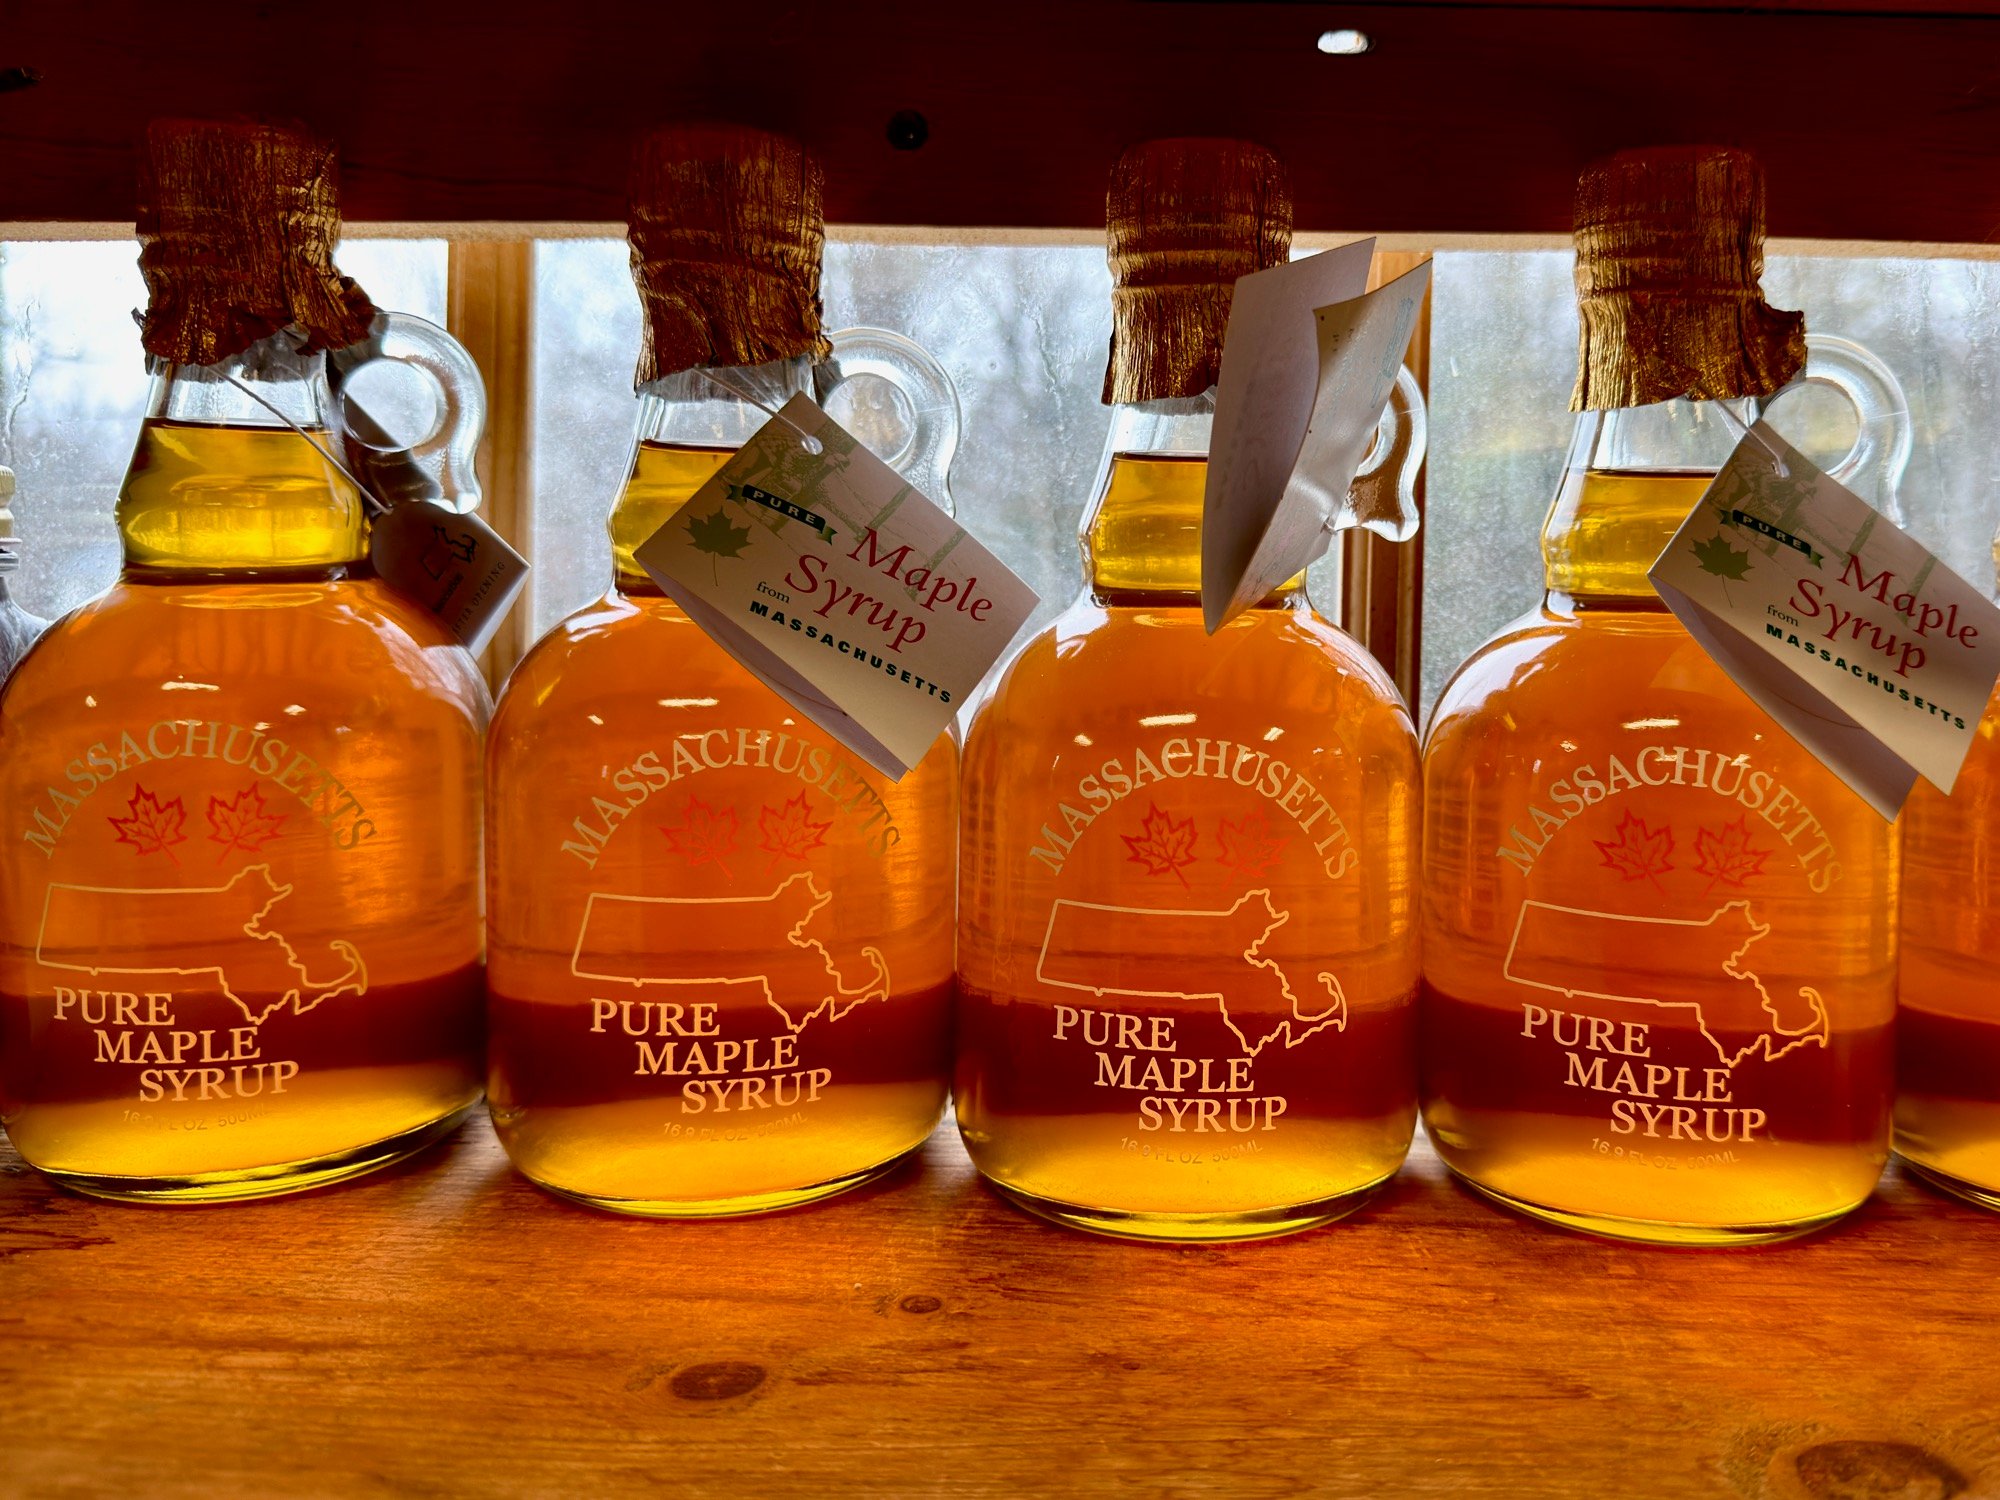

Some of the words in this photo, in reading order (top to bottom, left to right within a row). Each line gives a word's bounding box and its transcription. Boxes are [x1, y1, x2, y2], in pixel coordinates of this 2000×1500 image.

[751, 489, 817, 525] PURE
[1742, 514, 1801, 549] PURE
[473, 561, 506, 606] OPENING
[756, 581, 791, 604] from
[847, 526, 993, 622] Maple
[784, 553, 926, 654] Syrup
[1766, 604, 1800, 627] from
[1837, 553, 1979, 649] Maple
[1788, 577, 1926, 678] Syrup
[749, 600, 952, 704] MASSACHUSETTS
[1765, 623, 1965, 730] MASSACHUSETTS
[24, 720, 377, 860] MASSACHUSETTS
[561, 728, 901, 871] MASSACHUSETTS
[1029, 738, 1359, 880] MASSACHUSETTS
[1495, 745, 1844, 894] MASSACHUSETTS
[53, 986, 175, 1026] PURE
[590, 998, 720, 1036] PURE
[1053, 1004, 1177, 1052] PURE
[94, 1026, 261, 1064] MAPLE
[1520, 1003, 1650, 1058] PURE
[634, 1034, 799, 1075] MAPLE
[1094, 1052, 1254, 1092] MAPLE
[1564, 1052, 1732, 1102] MAPLE
[139, 1060, 299, 1102] SYRUP
[681, 1068, 832, 1114] SYRUP
[183, 1119, 208, 1131] OZ
[1139, 1096, 1287, 1132] SYRUP
[1610, 1100, 1766, 1142] SYRUP
[1179, 1152, 1203, 1164] OZ
